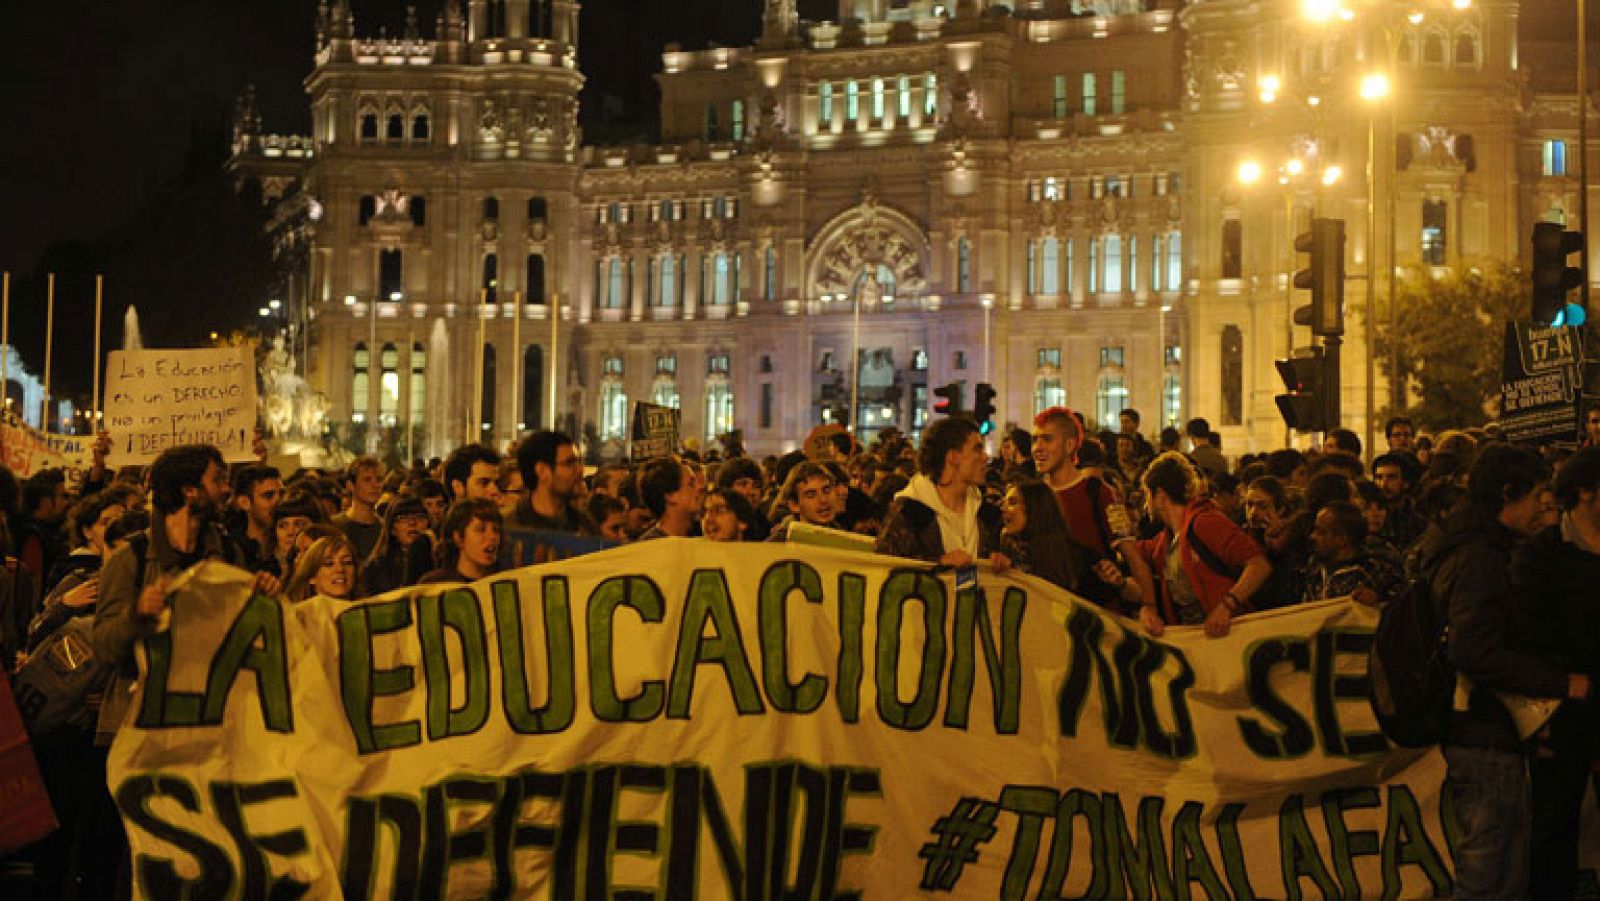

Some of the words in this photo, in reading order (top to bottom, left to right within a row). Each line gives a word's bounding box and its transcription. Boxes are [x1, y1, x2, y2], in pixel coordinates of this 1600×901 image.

[120, 357, 145, 379] La
[155, 358, 243, 378] Educación
[143, 393, 163, 403] un
[142, 416, 162, 425] un
[136, 595, 294, 734] LA
[1058, 603, 1197, 759] NO
[1234, 627, 1394, 760] SE
[115, 776, 312, 901] SE
[918, 782, 1460, 901] #TOMALAFA
